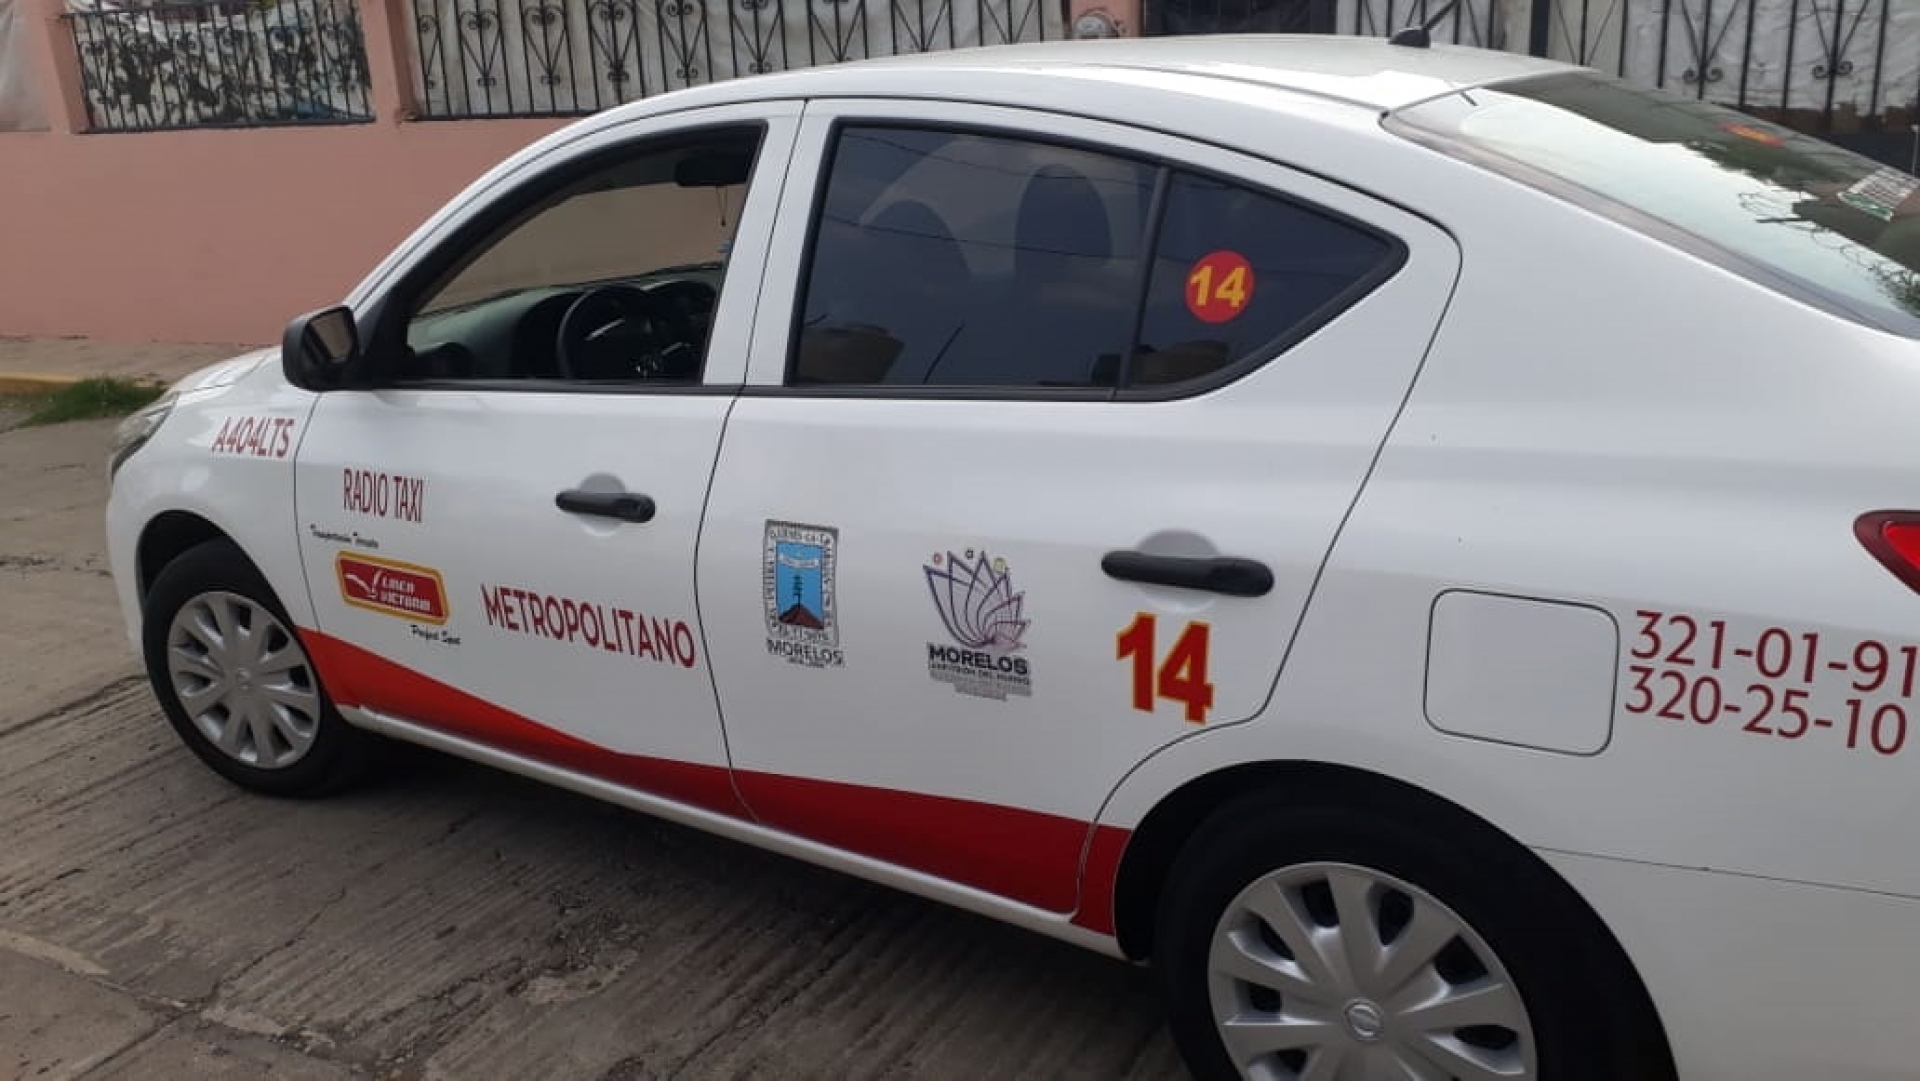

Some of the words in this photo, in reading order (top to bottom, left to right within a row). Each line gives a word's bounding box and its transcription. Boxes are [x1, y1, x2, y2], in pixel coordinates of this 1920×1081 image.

[1190, 265, 1246, 308] 14
[211, 416, 294, 457] A404LTS
[343, 468, 389, 516] RADIO
[392, 476, 423, 523] TAXI
[480, 583, 696, 668] METROPOLITANO
[766, 639, 843, 666] MORELOS
[929, 644, 1028, 675] MORELOS
[1115, 611, 1214, 726] 14
[1630, 609, 1918, 699] 321-01-91
[1625, 665, 1908, 756] 320-25-10
